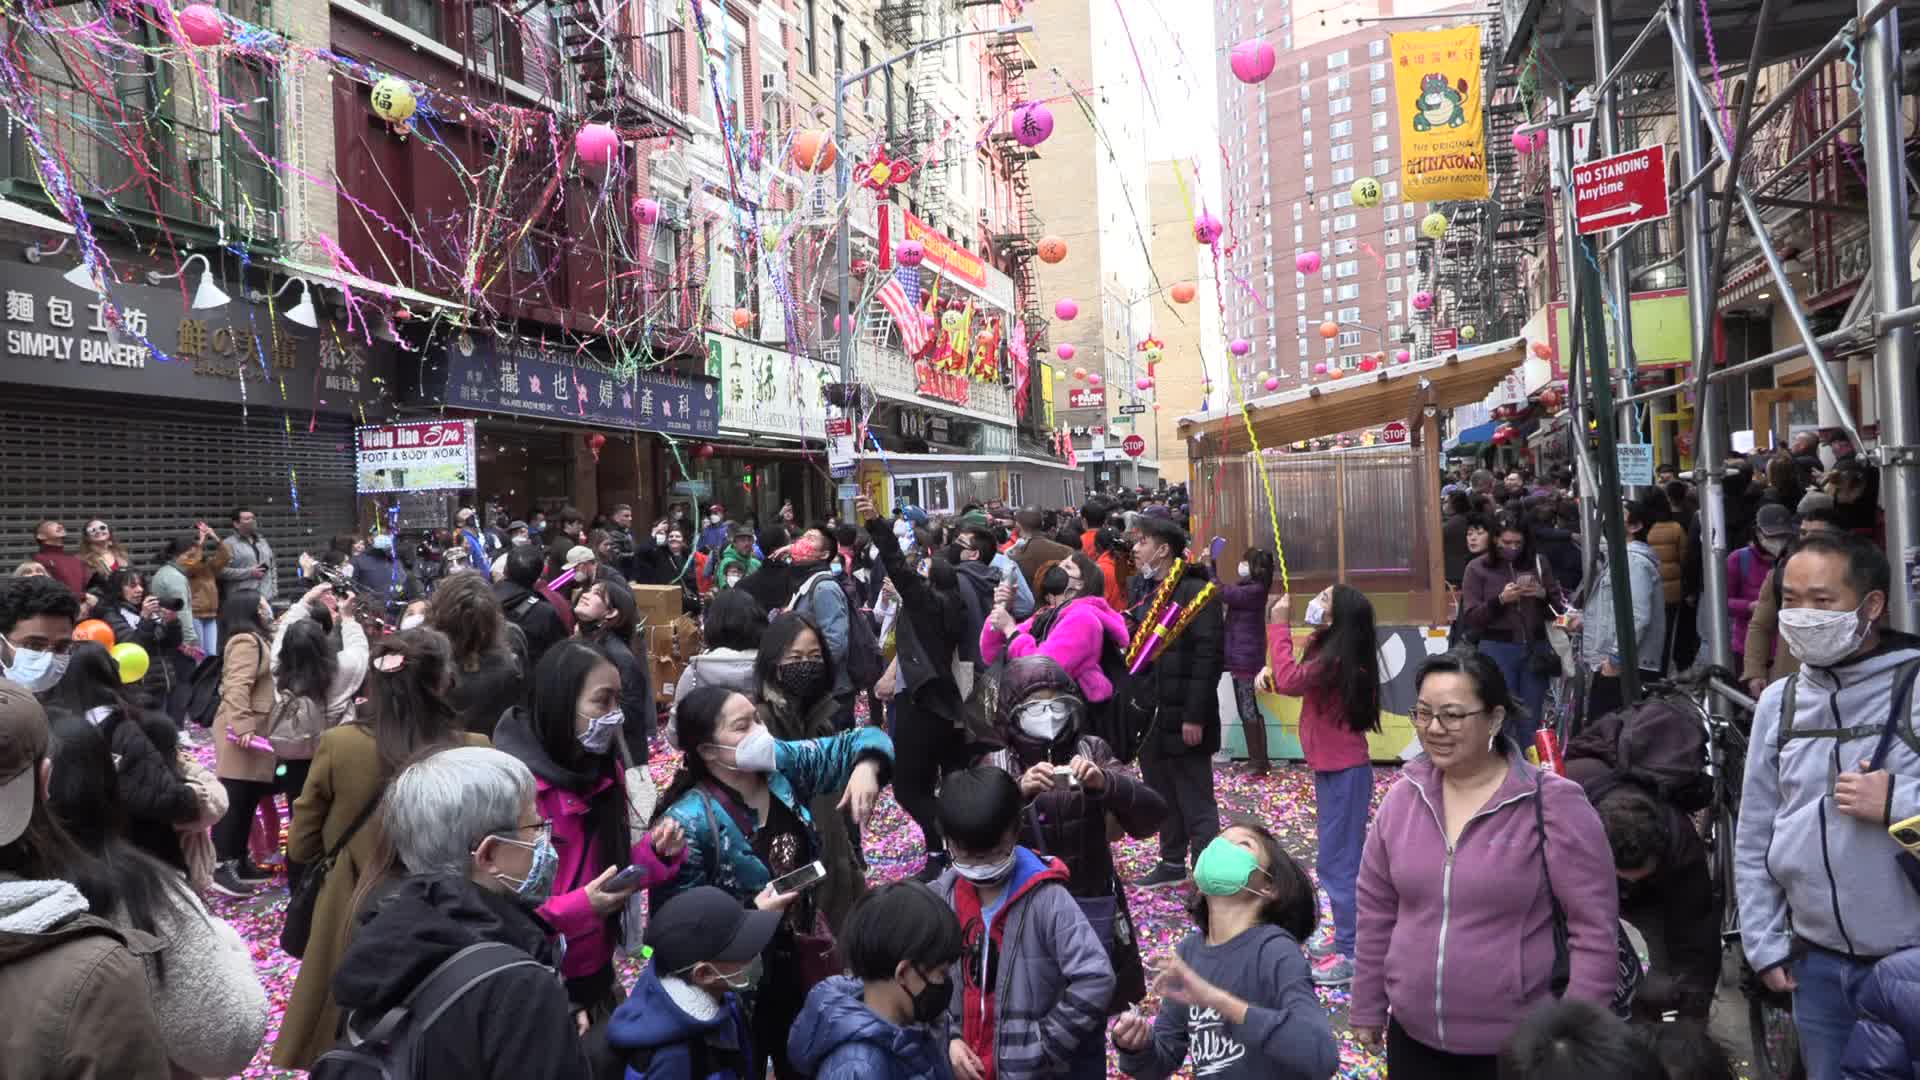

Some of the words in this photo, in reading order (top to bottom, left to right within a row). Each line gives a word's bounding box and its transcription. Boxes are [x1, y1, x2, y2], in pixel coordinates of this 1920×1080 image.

[1021, 112, 1044, 137] 春
[1407, 152, 1484, 175] CHINATOWN
[1576, 170, 1592, 185] NO
[1594, 156, 1650, 182] STANDING
[1360, 181, 1377, 199] 福
[1578, 181, 1624, 201] Anytime
[8, 329, 75, 360] SIMPLY
[80, 338, 146, 369] BAKERY
[1078, 393, 1103, 402] PARK
[423, 425, 461, 448] Spa
[1383, 428, 1405, 440] STOP
[362, 452, 388, 463] FOOT
[401, 449, 428, 461] BODY
[433, 447, 463, 459] WORK
[1123, 440, 1144, 451] STOP
